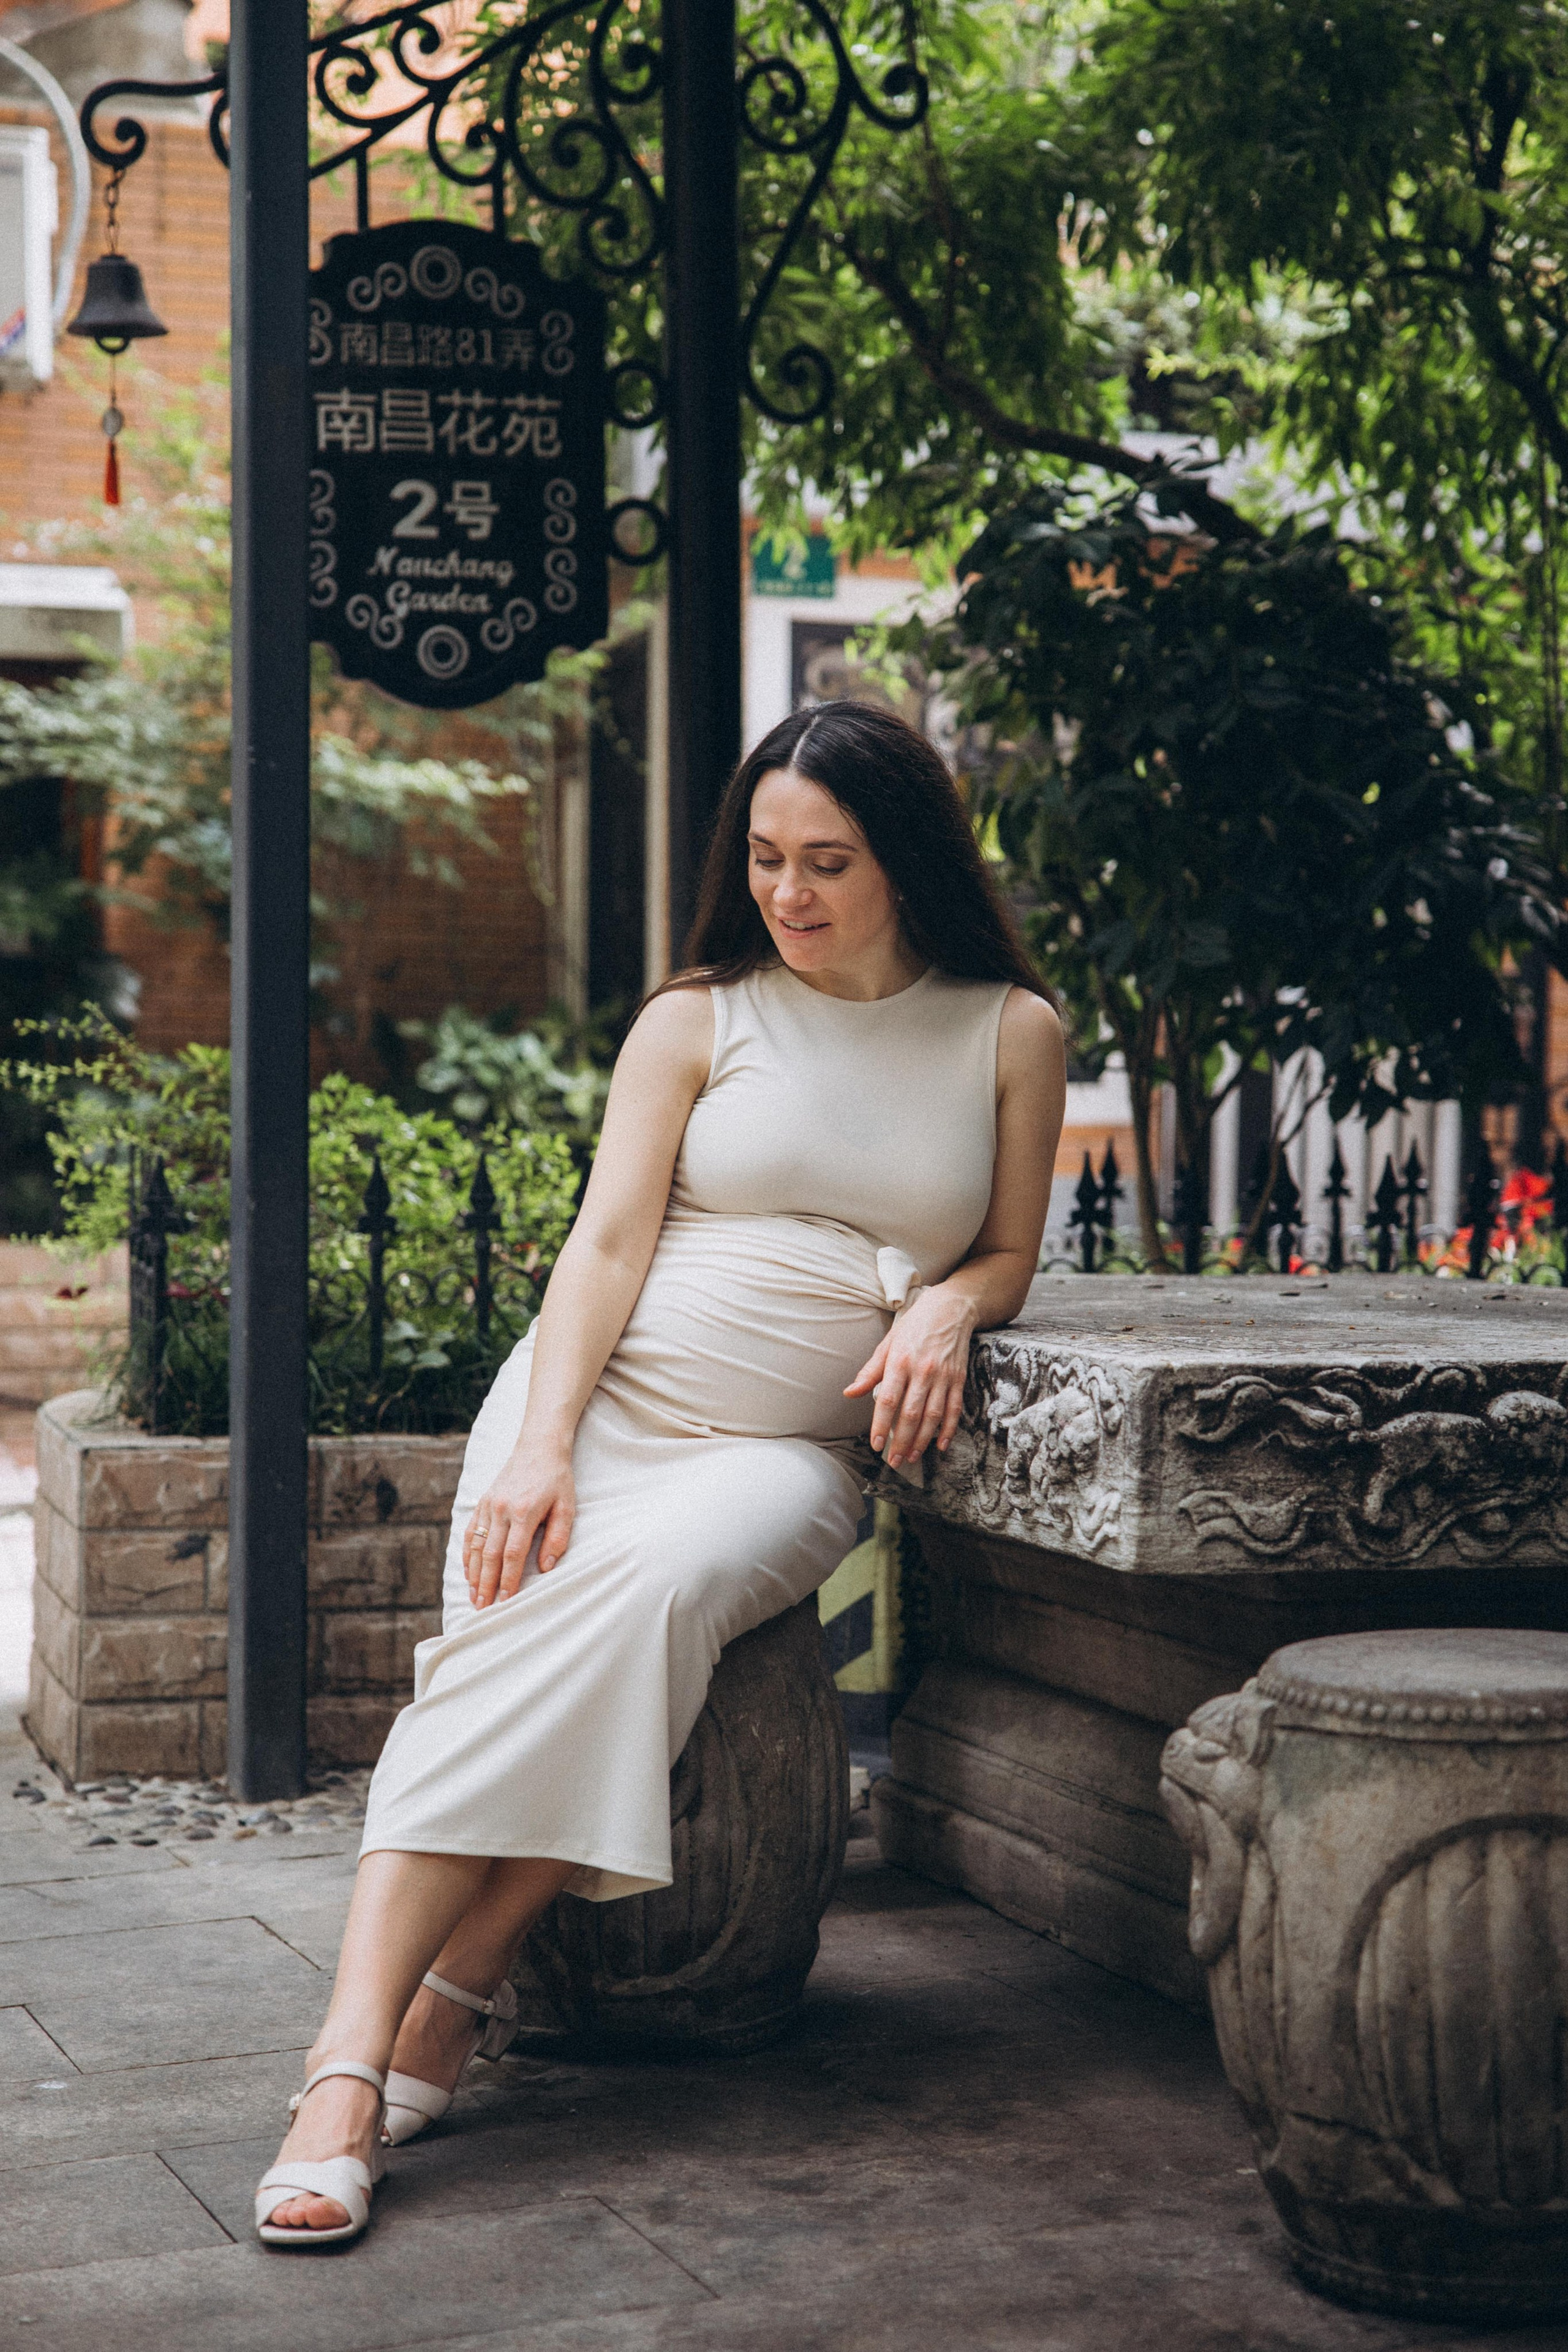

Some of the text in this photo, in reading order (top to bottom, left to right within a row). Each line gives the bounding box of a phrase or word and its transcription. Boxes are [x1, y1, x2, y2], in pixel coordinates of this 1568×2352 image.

[339, 322, 535, 369] 南昌路81弄
[313, 387, 562, 458] 南昌花苑
[390, 479, 499, 541] 2号
[368, 546, 514, 587] Nanchang
[386, 581, 492, 616] Garden
